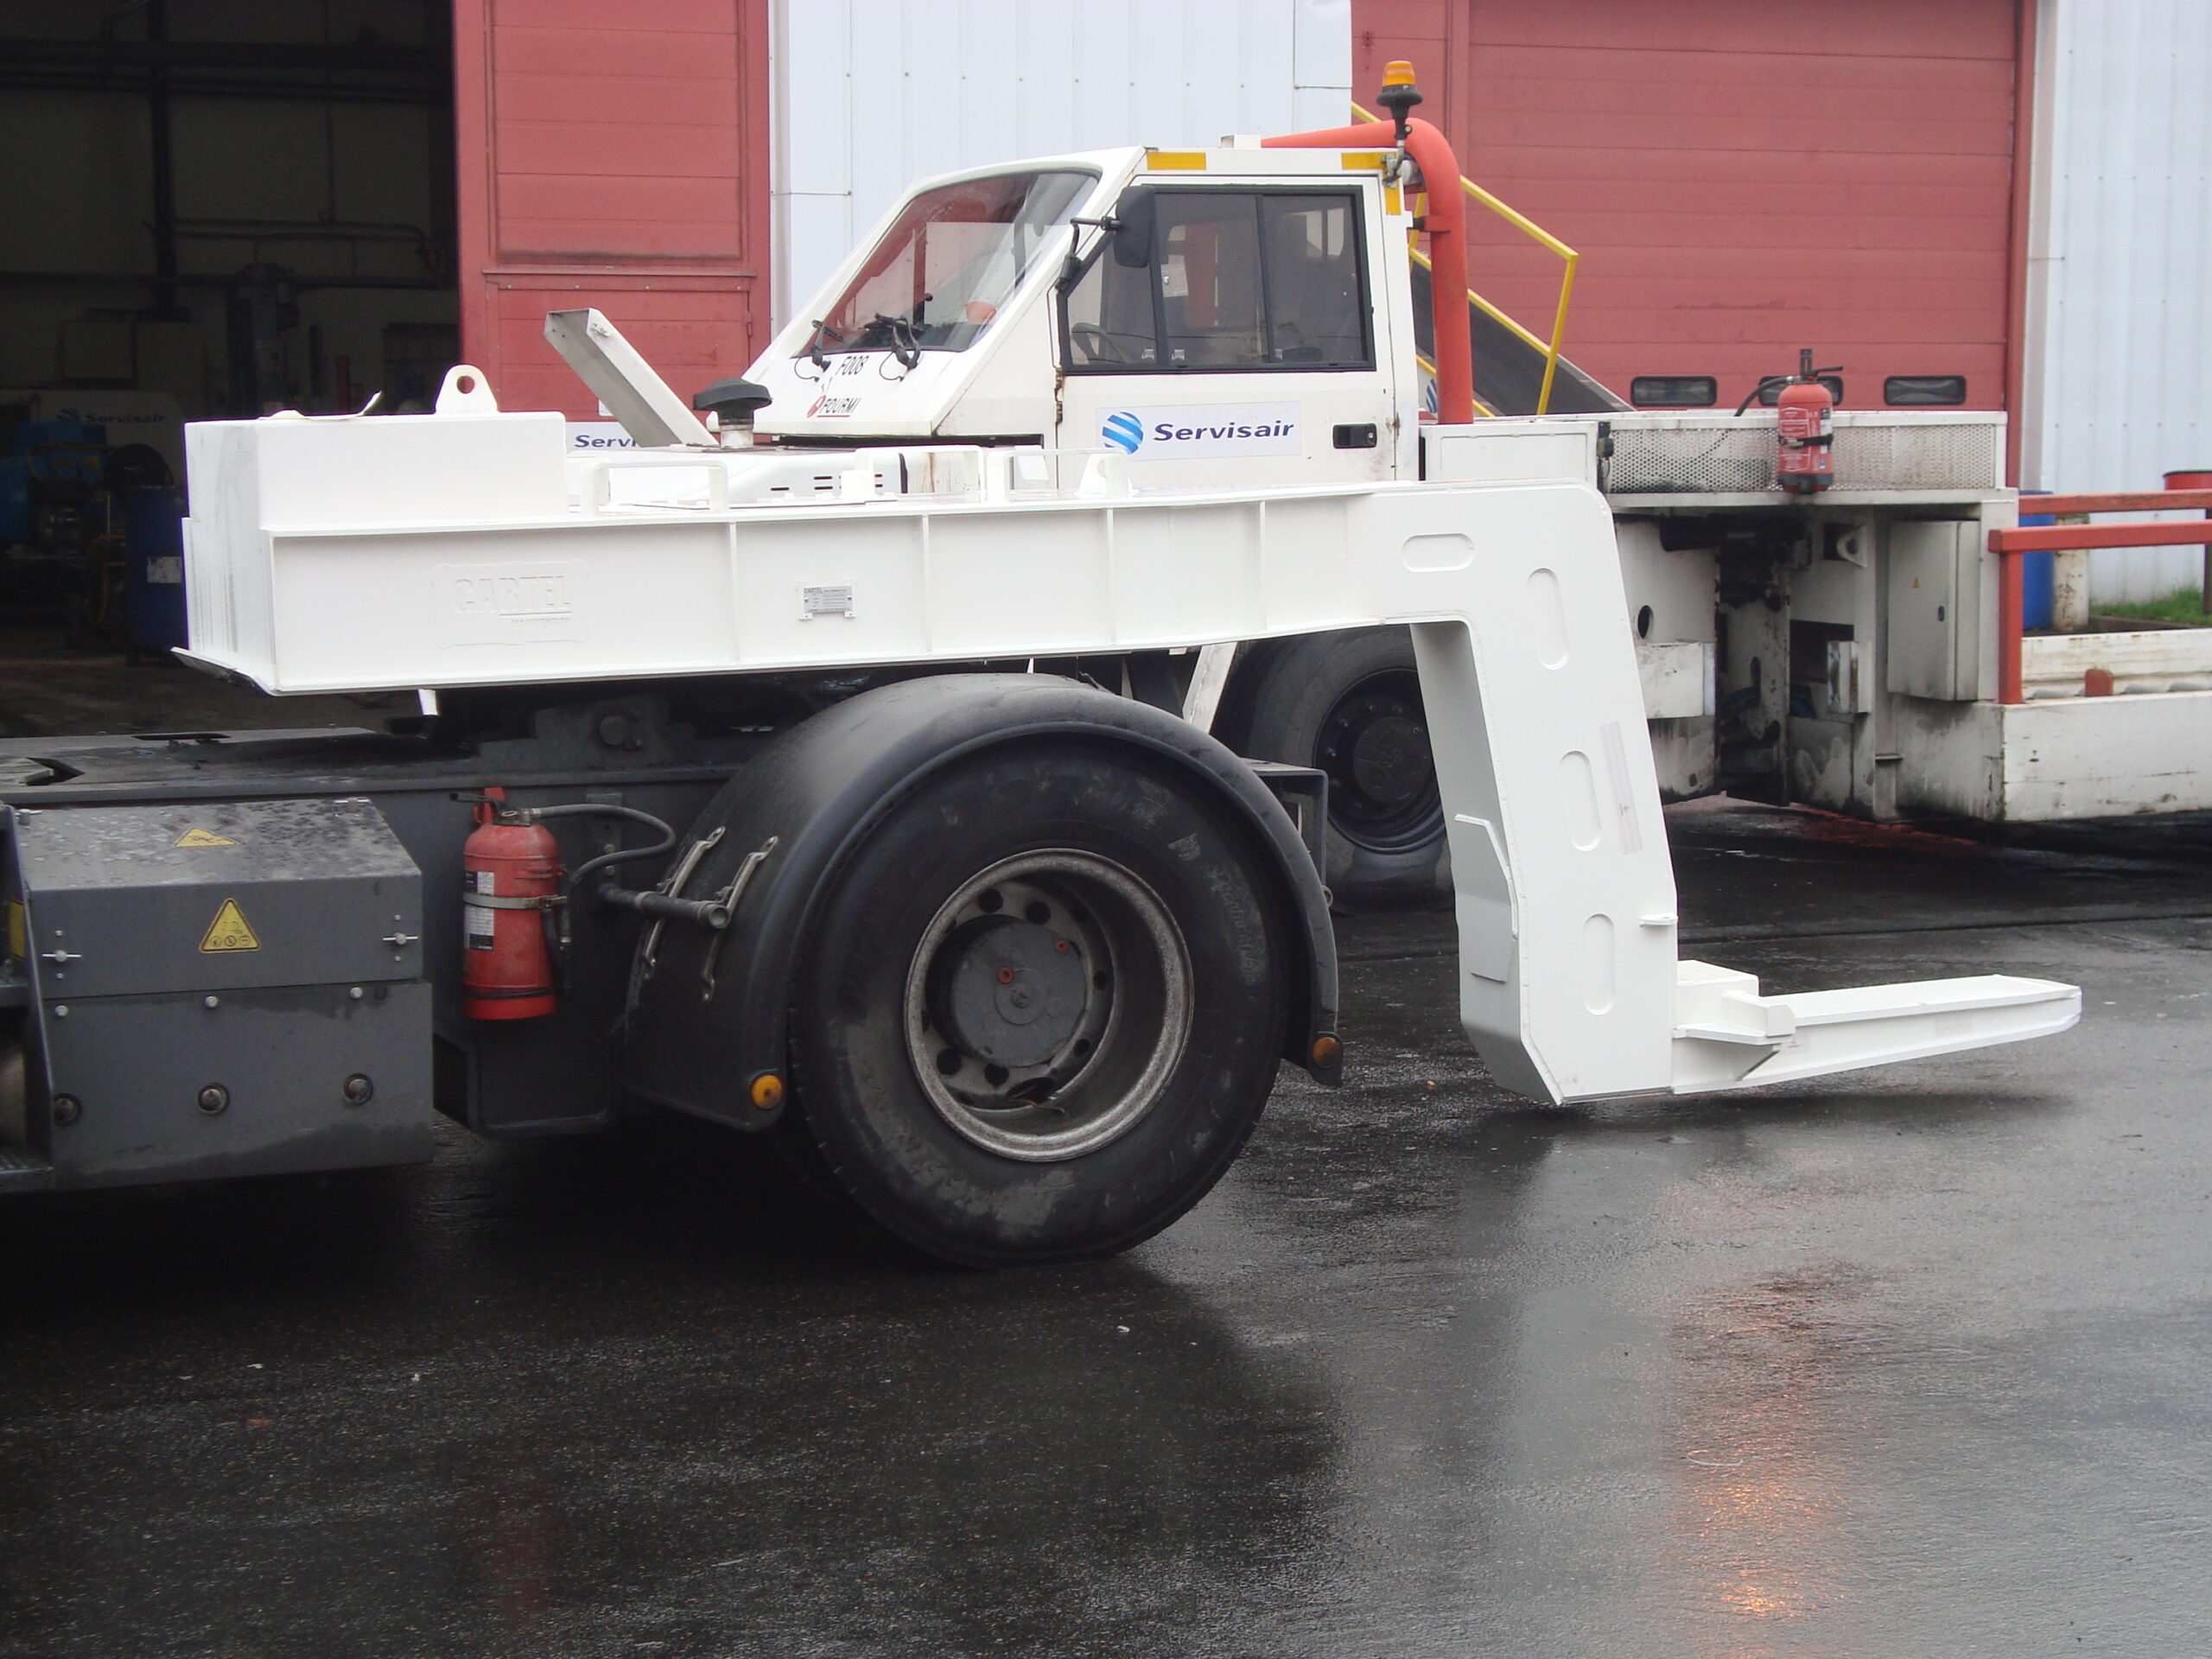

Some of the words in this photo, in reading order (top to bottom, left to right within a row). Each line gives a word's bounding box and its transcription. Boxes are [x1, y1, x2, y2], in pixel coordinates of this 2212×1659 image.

[835, 355, 870, 376] F008
[819, 397, 862, 414] FOURMI
[85, 413, 166, 423] Servisair
[1154, 420, 1294, 442] Servisair
[454, 576, 570, 613] CARTEL
